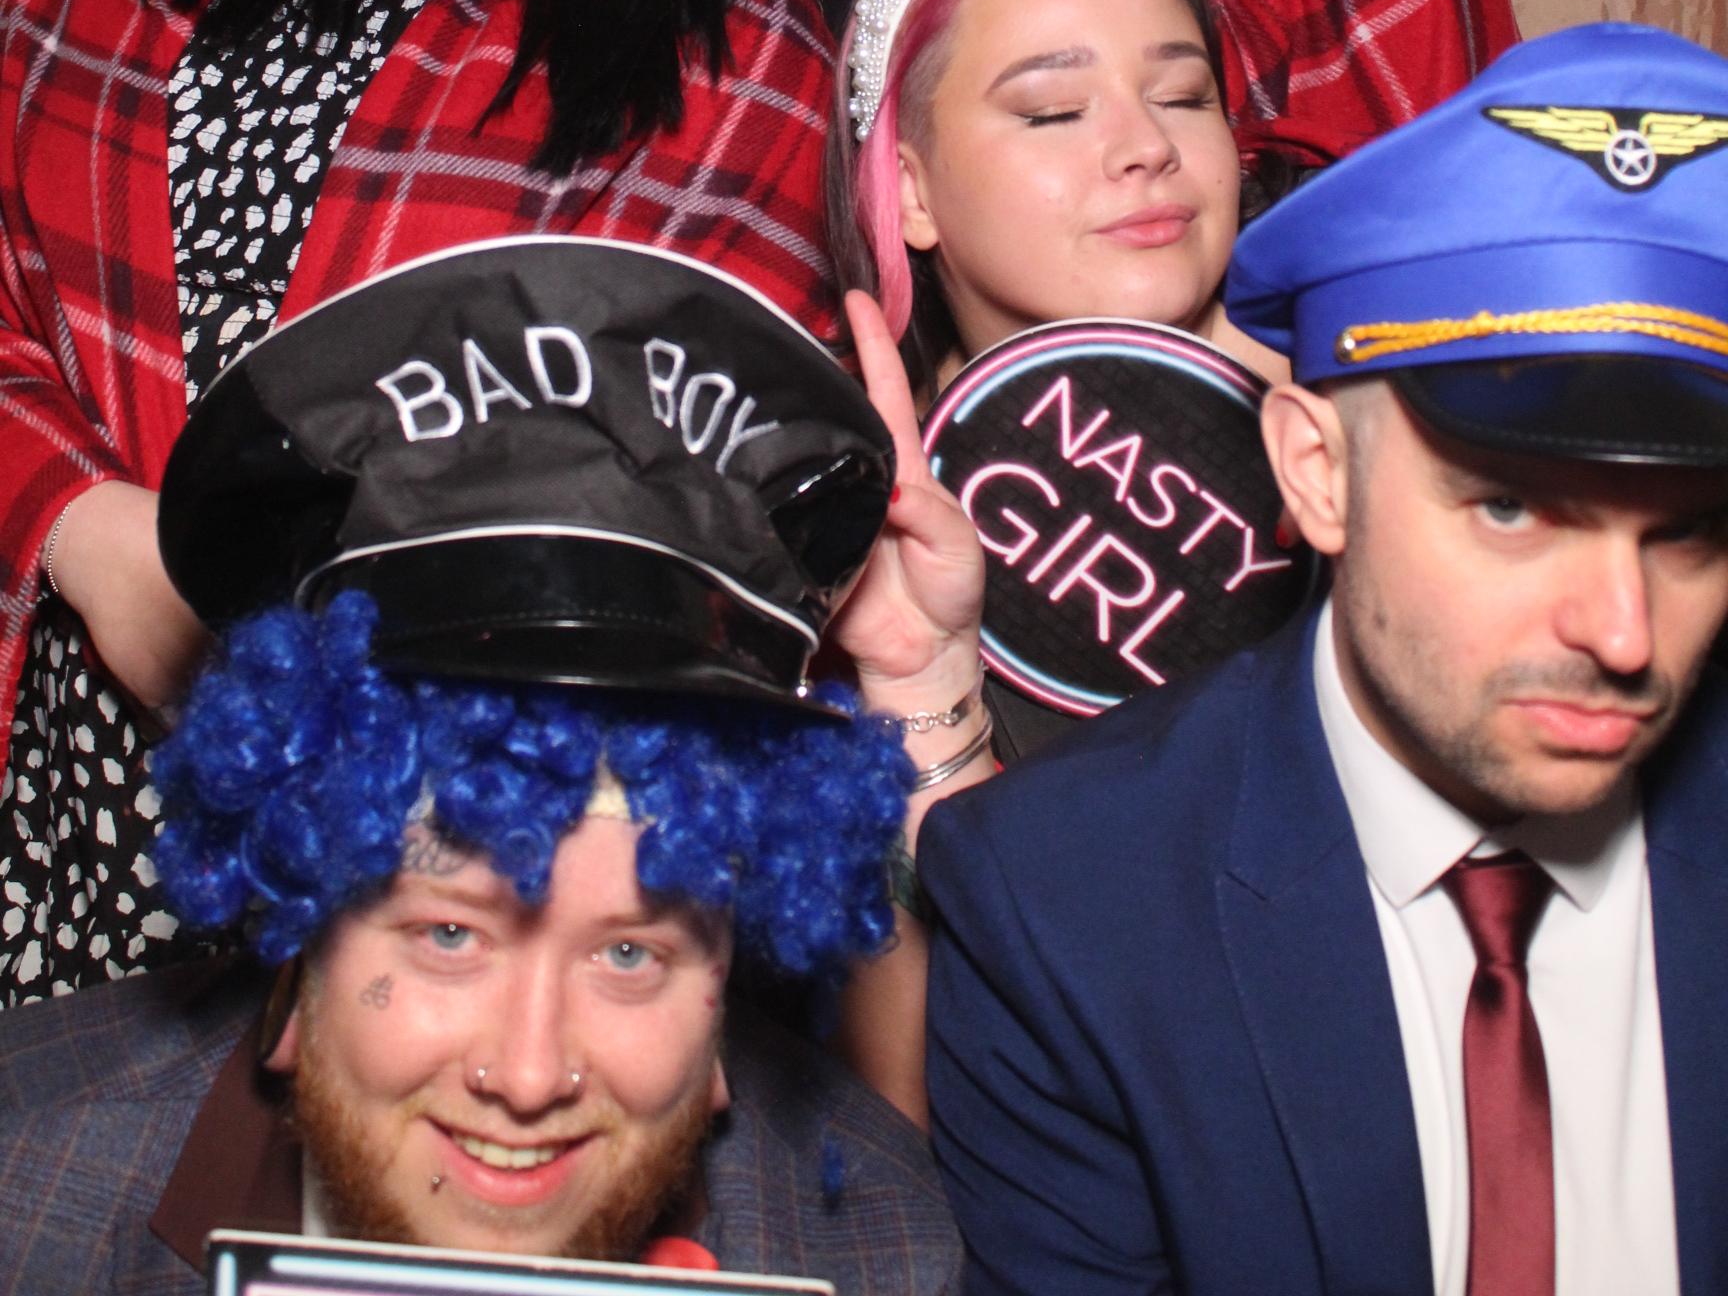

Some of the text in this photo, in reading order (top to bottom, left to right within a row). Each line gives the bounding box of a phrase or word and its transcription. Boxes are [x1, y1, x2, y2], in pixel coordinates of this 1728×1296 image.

[375, 325, 780, 476] BAD BOY
[1022, 375, 1293, 592] NASTY
[960, 462, 1185, 686] GIRL
